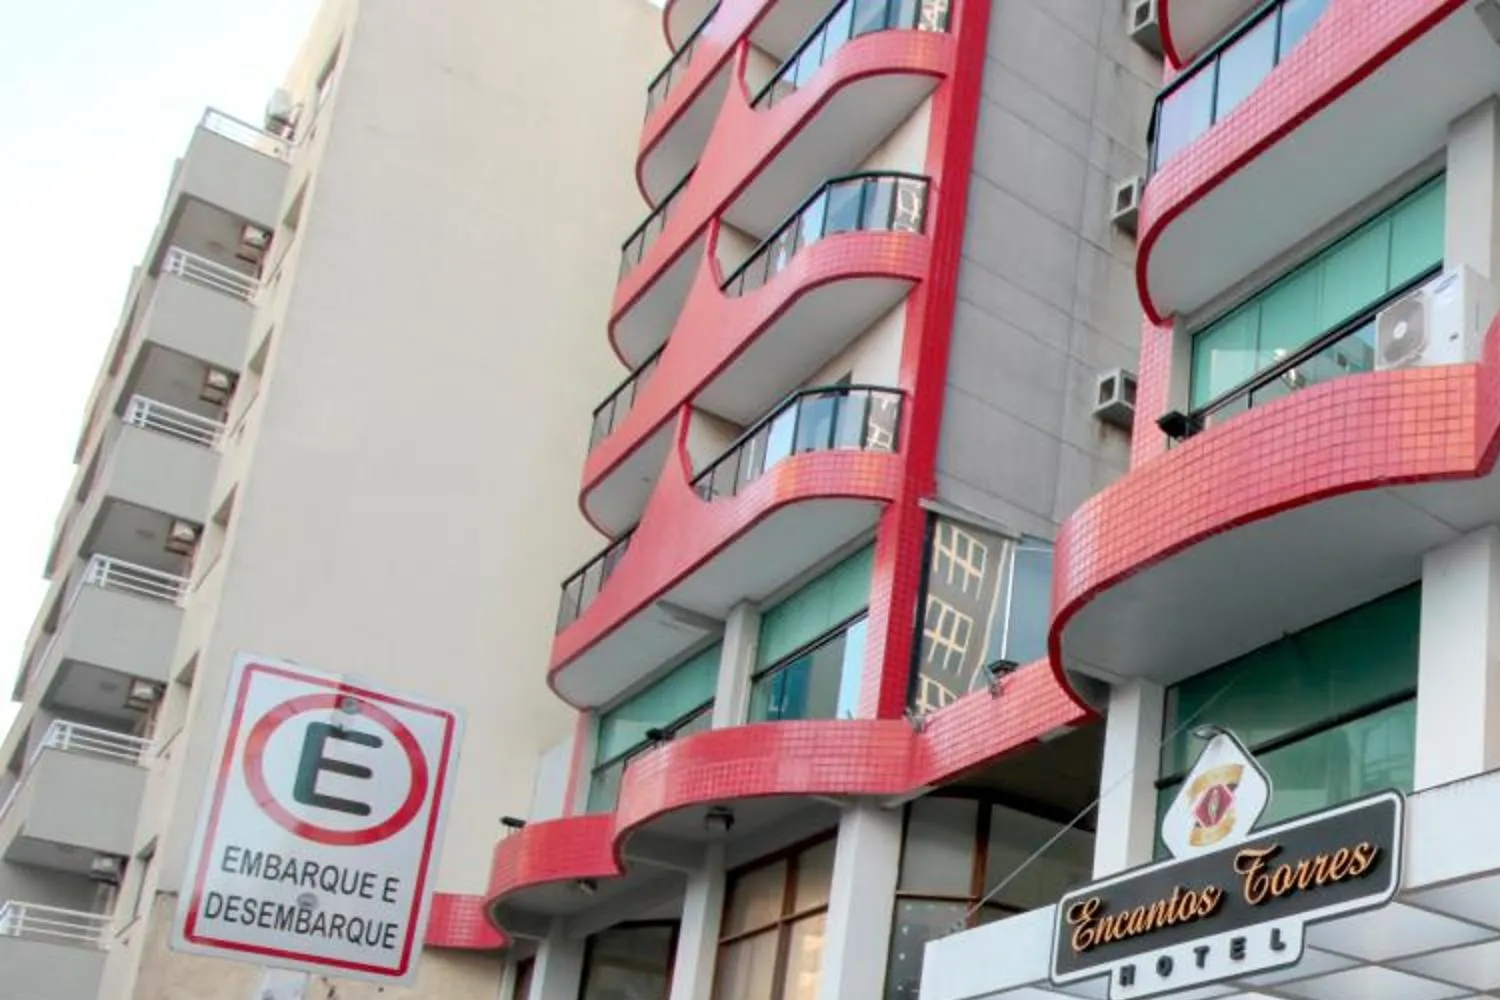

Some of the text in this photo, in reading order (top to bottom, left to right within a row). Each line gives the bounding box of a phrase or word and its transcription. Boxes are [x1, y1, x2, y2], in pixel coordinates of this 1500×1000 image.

[293, 720, 384, 817] E
[220, 845, 400, 904] EMBARQUE E
[1066, 841, 1379, 952] Encantos Torres
[203, 891, 399, 950] DESEMBARQUE
[1119, 927, 1287, 988] HOTEL
